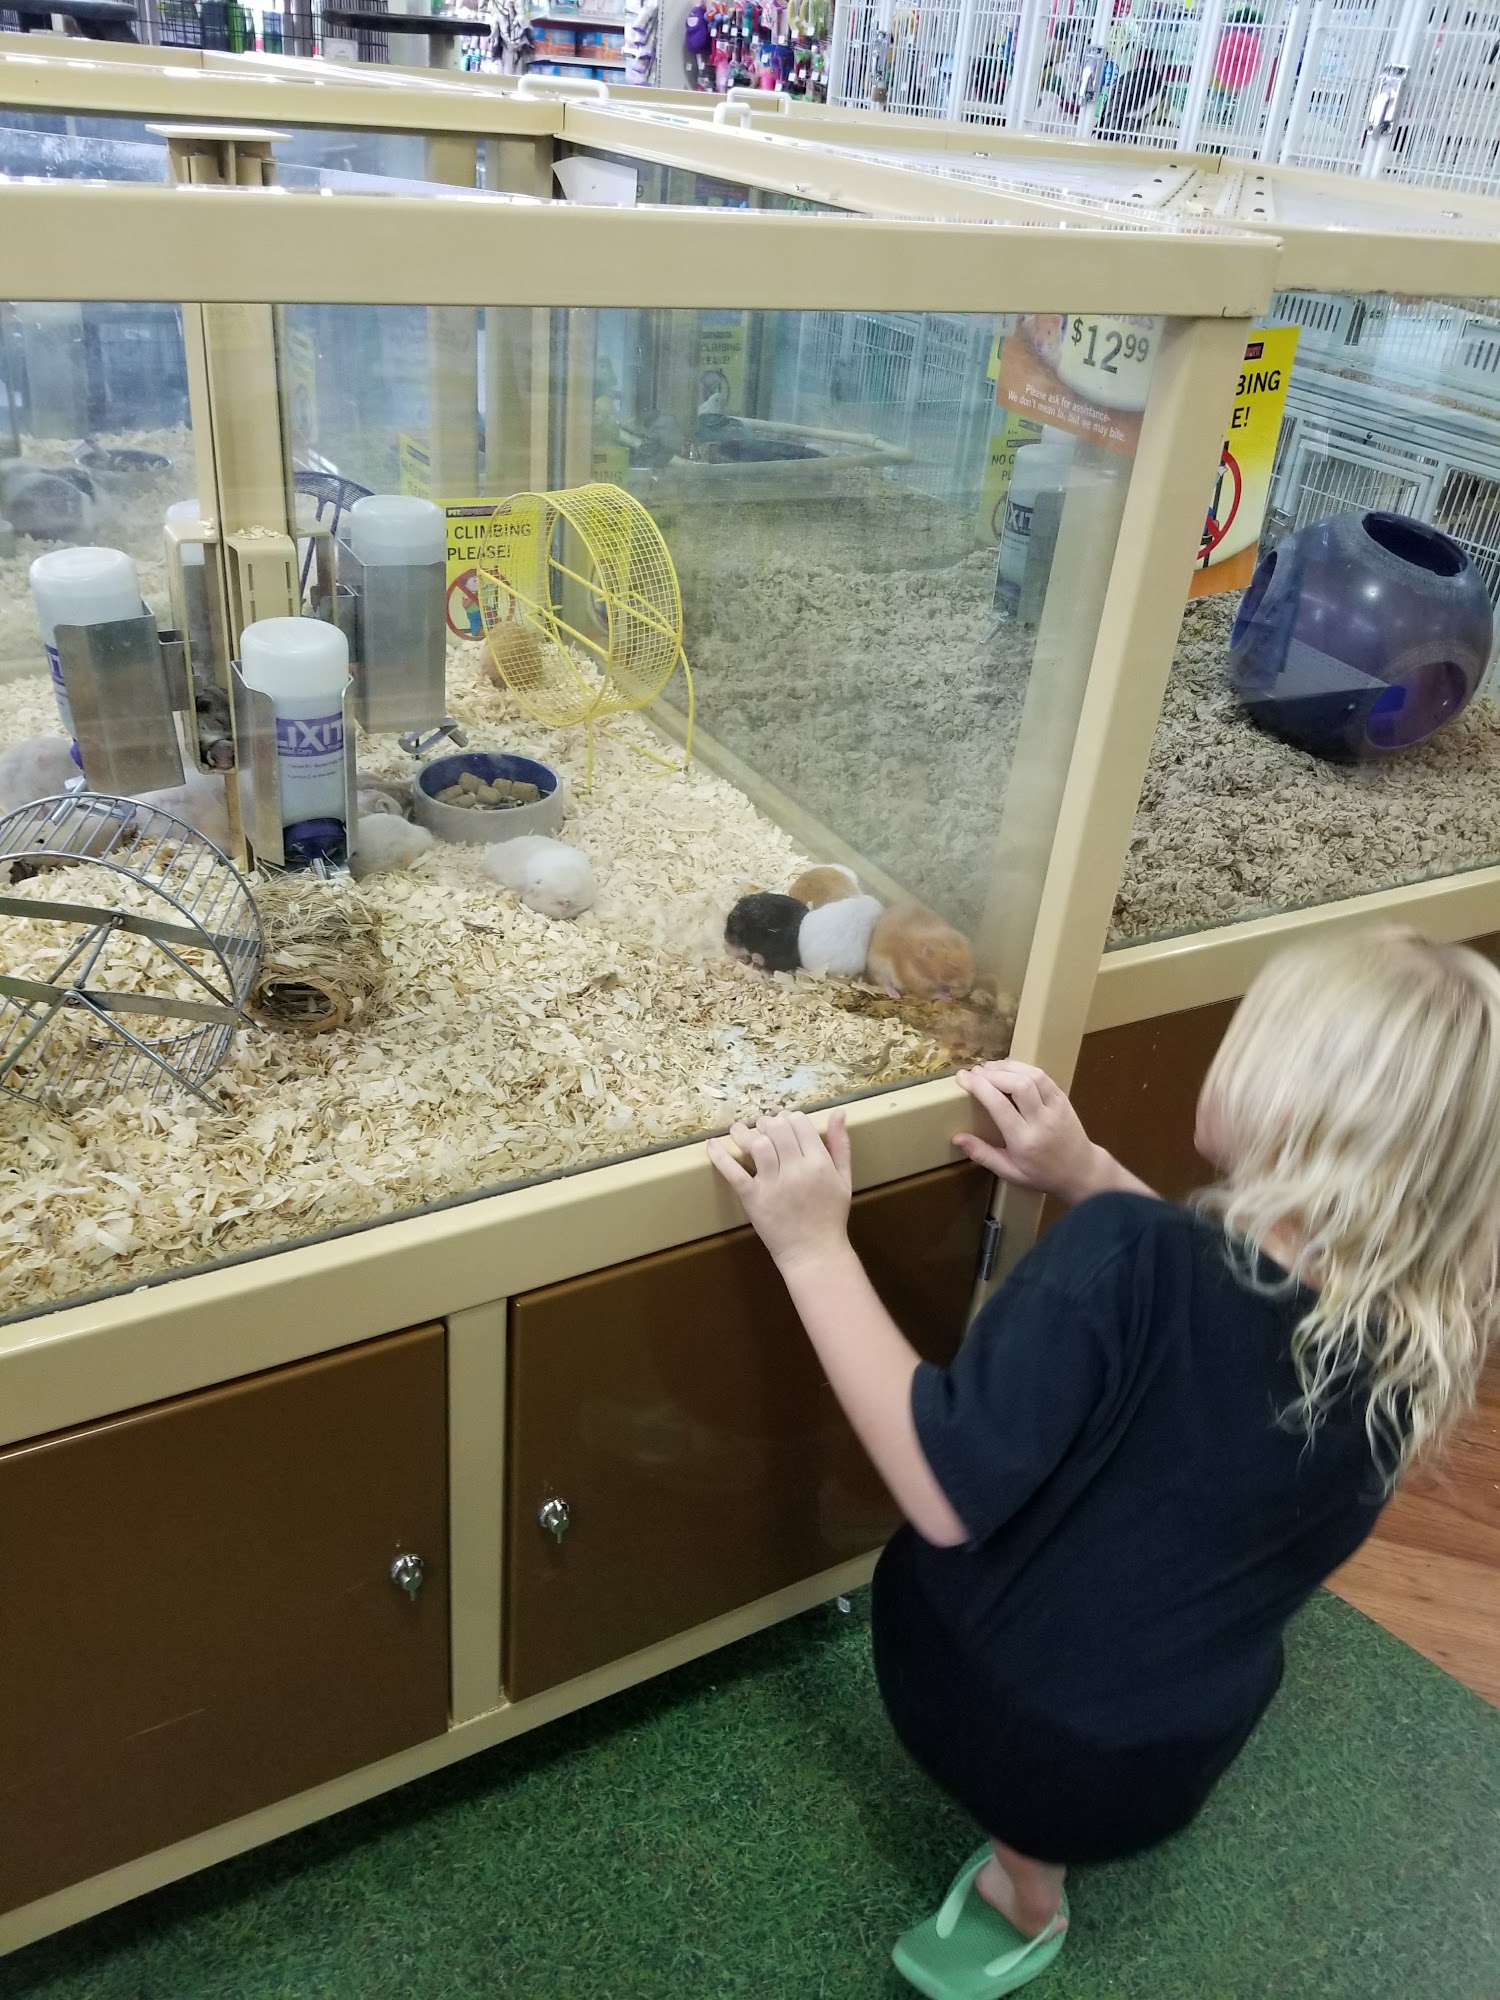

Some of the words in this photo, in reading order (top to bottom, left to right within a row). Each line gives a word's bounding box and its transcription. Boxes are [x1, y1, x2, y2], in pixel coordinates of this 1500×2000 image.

[1025, 384, 1047, 400] Please
[1047, 394, 1060, 404] ask
[1061, 397, 1071, 409] for
[1008, 390, 1019, 402] We
[1019, 395, 1037, 408] don't
[1037, 403, 1056, 416] mean
[1067, 412, 1080, 425] but
[1081, 419, 1091, 429] we
[1093, 423, 1108, 438] may
[992, 454, 1006, 466] NO
[454, 523, 531, 540] CLIMBING
[447, 544, 510, 561] PLEASE!
